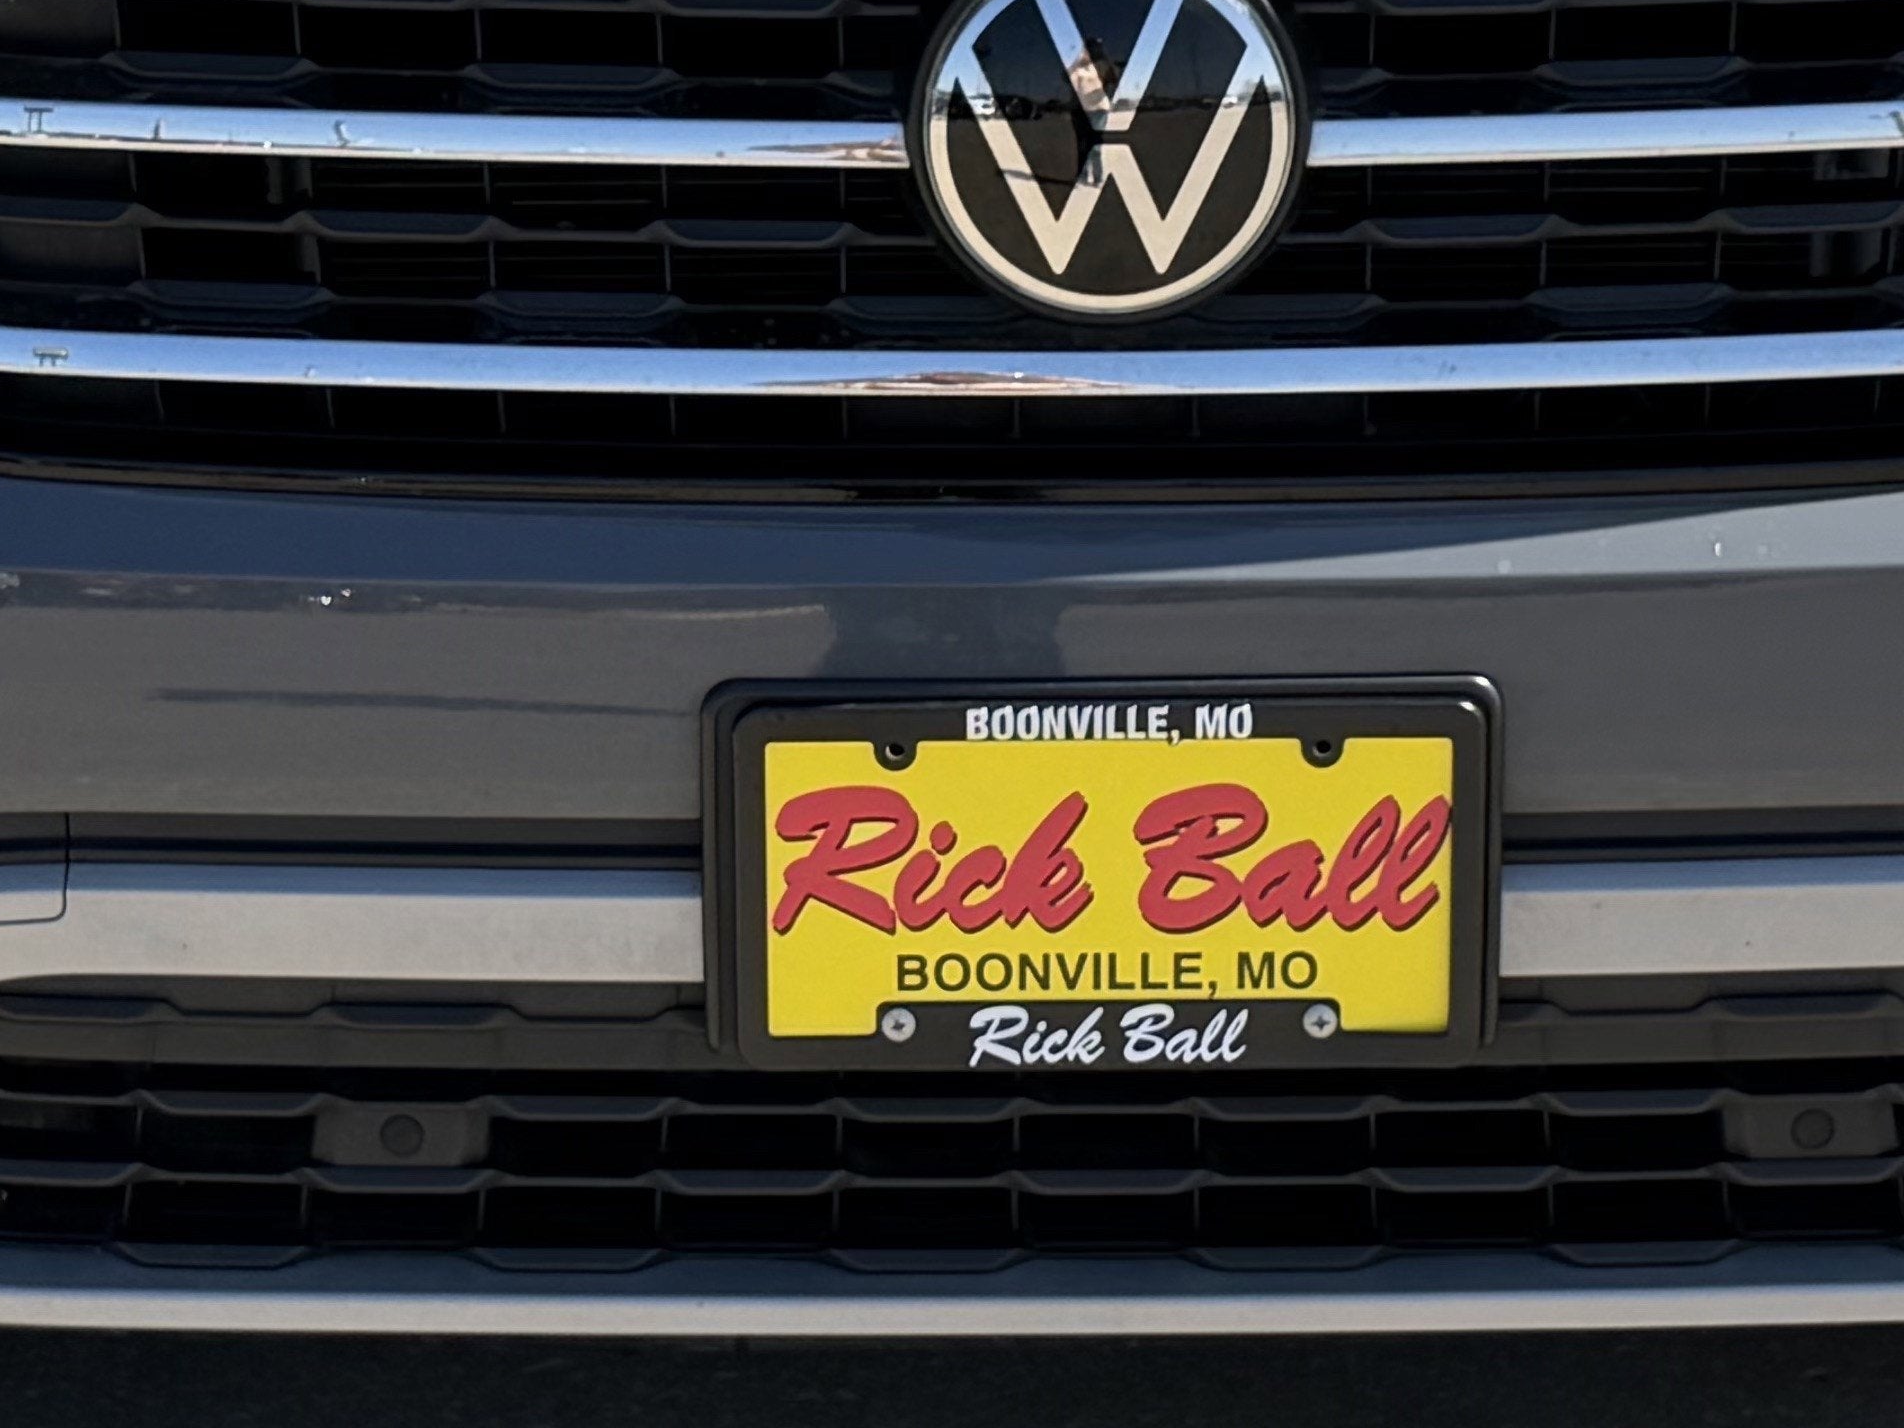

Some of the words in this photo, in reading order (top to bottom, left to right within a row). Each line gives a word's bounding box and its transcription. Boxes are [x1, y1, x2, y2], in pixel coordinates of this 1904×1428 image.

[966, 704, 1181, 745] BOONVILLE,
[1195, 703, 1253, 739] MO
[772, 784, 1095, 936] Rick
[1133, 782, 1453, 934] Ball
[896, 952, 1217, 998] BOONVILLE,
[1237, 951, 1318, 990] MO
[969, 1006, 1106, 1068] Rick
[1121, 1003, 1247, 1065] Ball
